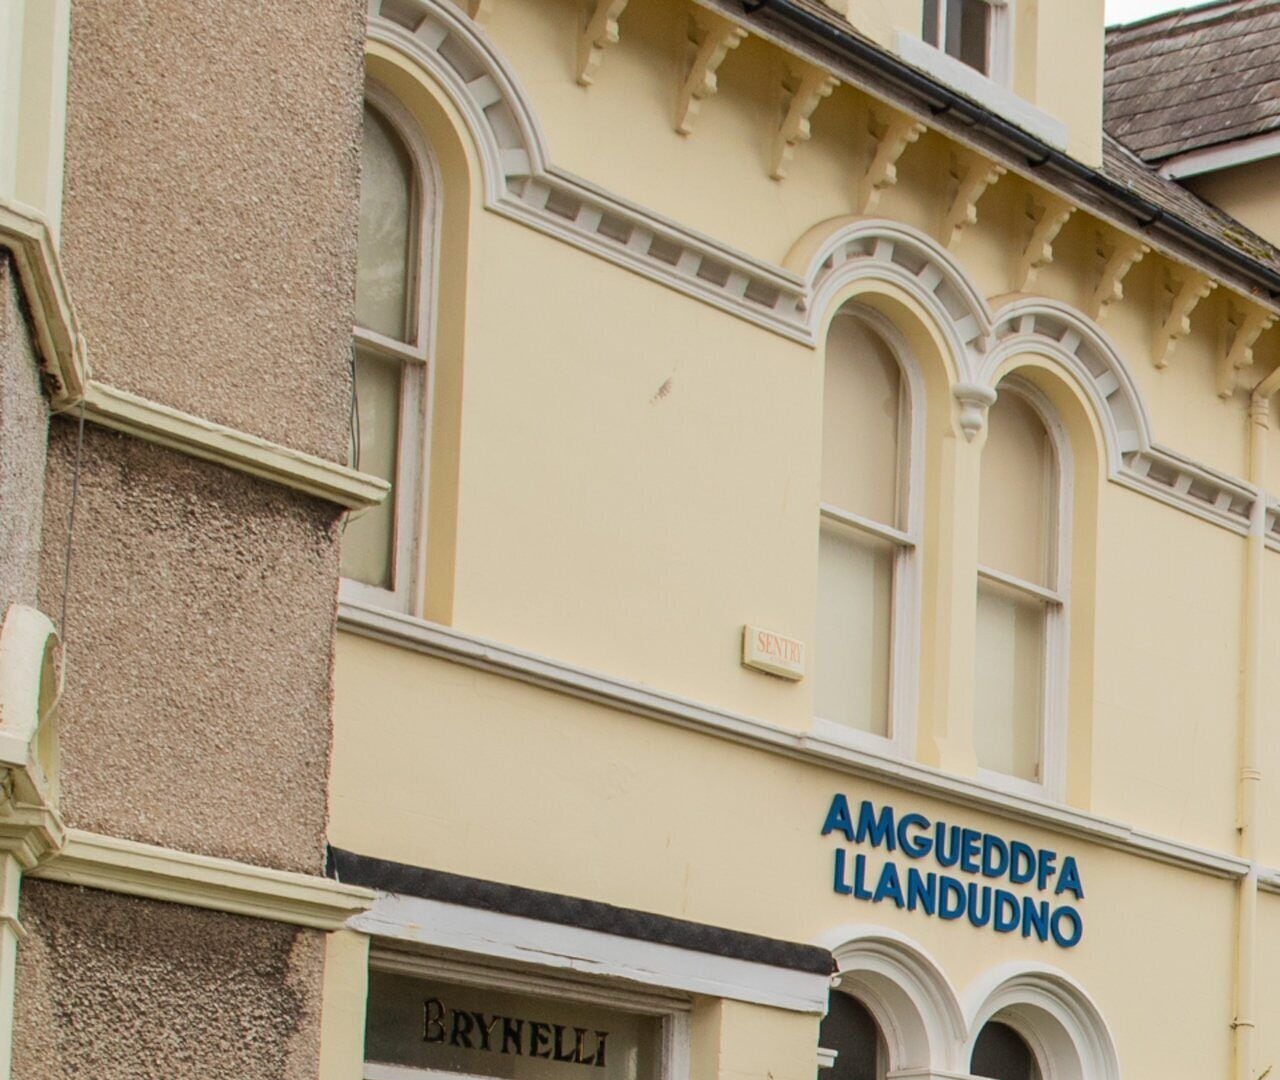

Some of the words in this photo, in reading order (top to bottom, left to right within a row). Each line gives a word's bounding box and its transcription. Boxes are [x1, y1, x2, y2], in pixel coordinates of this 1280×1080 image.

[757, 631, 803, 665] SENTRY
[821, 793, 1084, 900] AMGUEDDFA
[833, 848, 1082, 948] LLANDUDNO
[423, 997, 609, 1067] BRYNELLI
